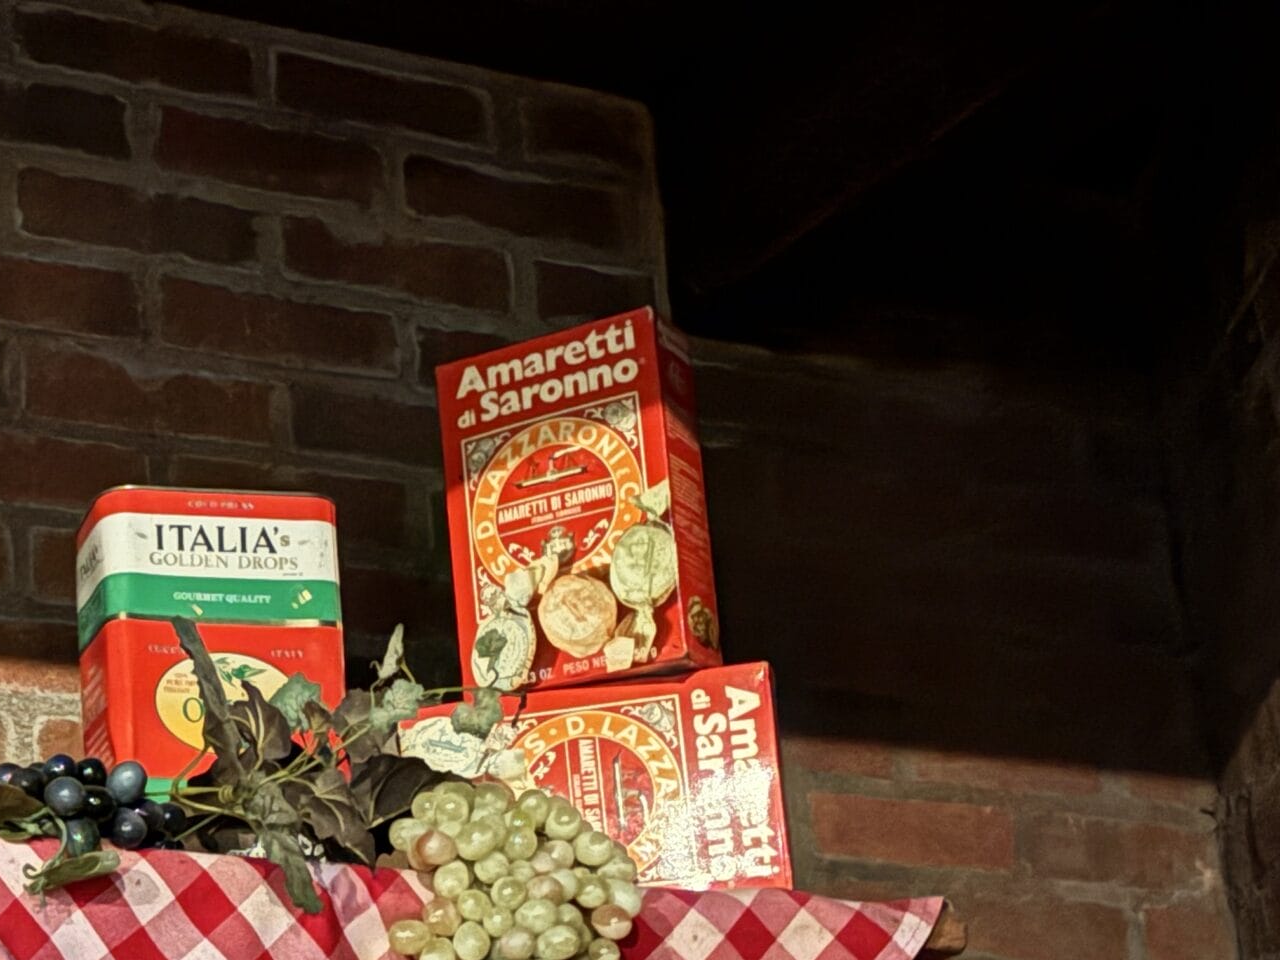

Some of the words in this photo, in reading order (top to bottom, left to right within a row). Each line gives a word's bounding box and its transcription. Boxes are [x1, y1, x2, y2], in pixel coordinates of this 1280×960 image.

[456, 319, 636, 399] Amaretti
[457, 409, 476, 429] di
[479, 358, 639, 422] Saronno
[478, 421, 626, 506] LAZZARONI
[498, 498, 548, 525] AMARETTI
[550, 495, 562, 511] DI
[564, 482, 613, 508] SARONNO
[155, 523, 291, 554] ITALIA's
[149, 551, 229, 569] GOLDEN
[238, 555, 298, 571] DROPS
[173, 591, 224, 603] GOURMET
[225, 593, 272, 604] QUALITY
[562, 660, 590, 676] PESO
[690, 688, 711, 710] di
[577, 738, 598, 792] AMARETTI
[724, 685, 781, 878] Amaetti
[583, 793, 600, 805] DI
[693, 712, 739, 882] Sarnno
